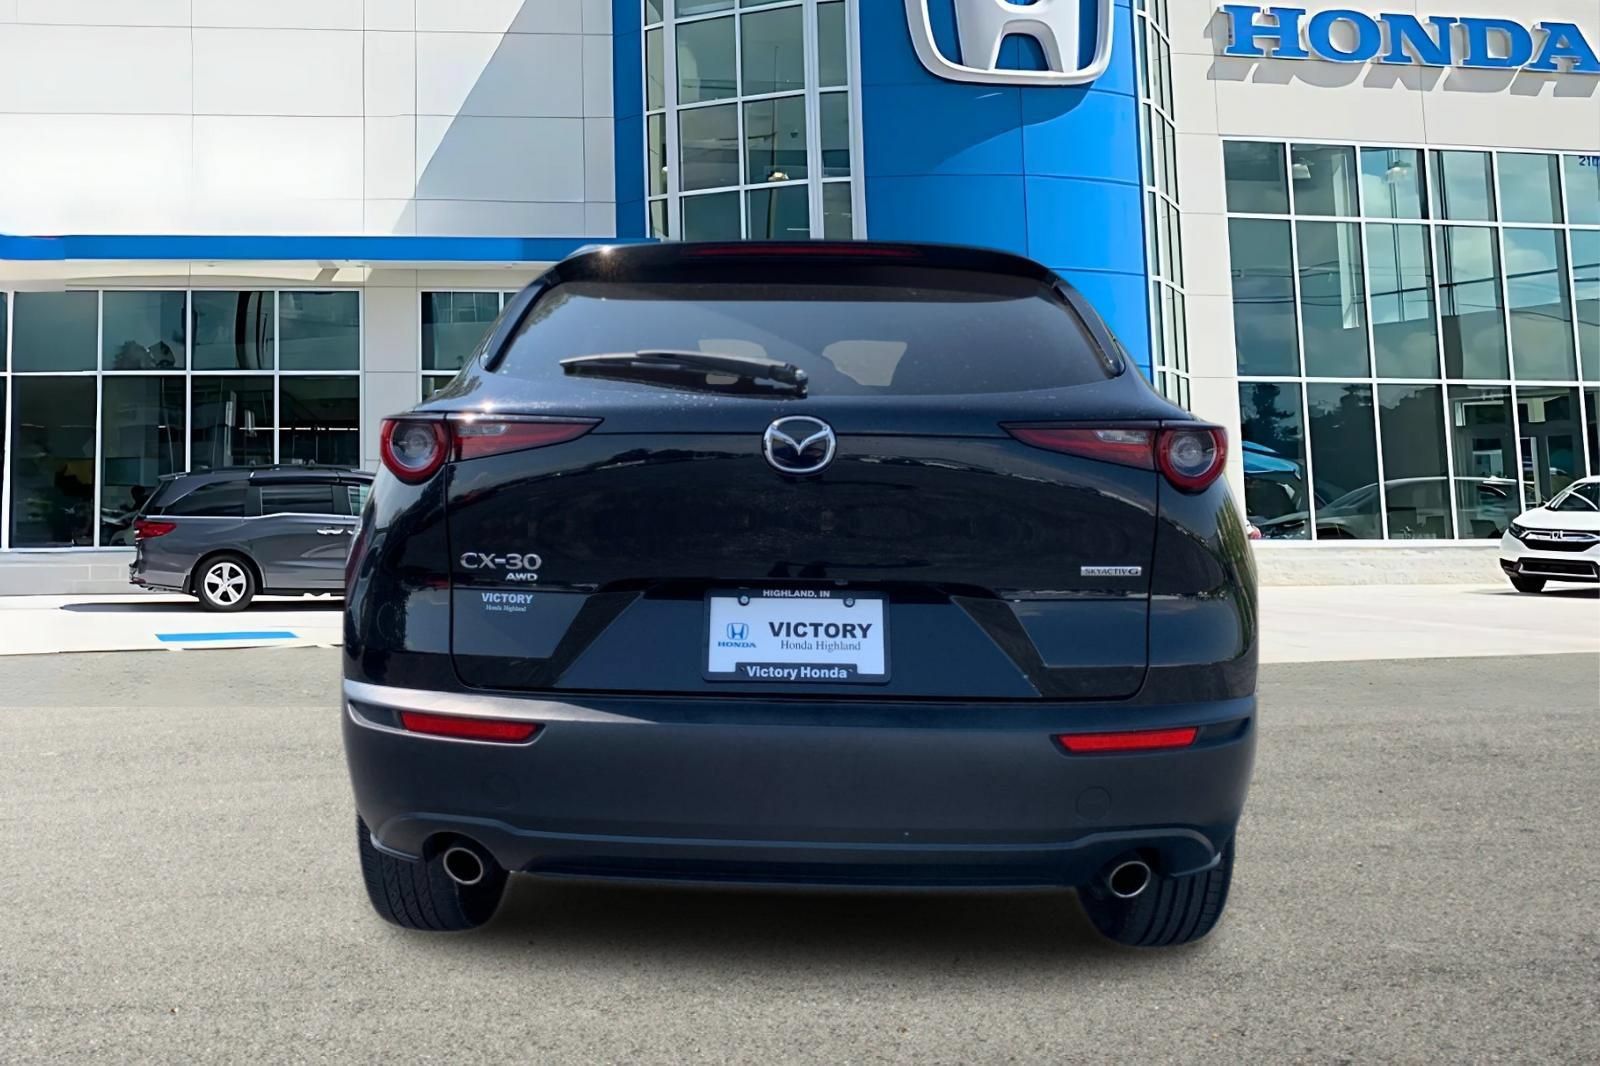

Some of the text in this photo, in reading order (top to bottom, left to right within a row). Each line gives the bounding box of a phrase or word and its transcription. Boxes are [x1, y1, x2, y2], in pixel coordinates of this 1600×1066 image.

[1221, 4, 1600, 73] HONDA
[460, 552, 542, 570] CX-30
[505, 572, 538, 581] AWD
[481, 592, 534, 604] VICTORY
[819, 590, 831, 598] IN
[768, 622, 872, 638] VICTORY
[780, 640, 861, 652] Honda Highland
[747, 666, 848, 680] Victory Honda
